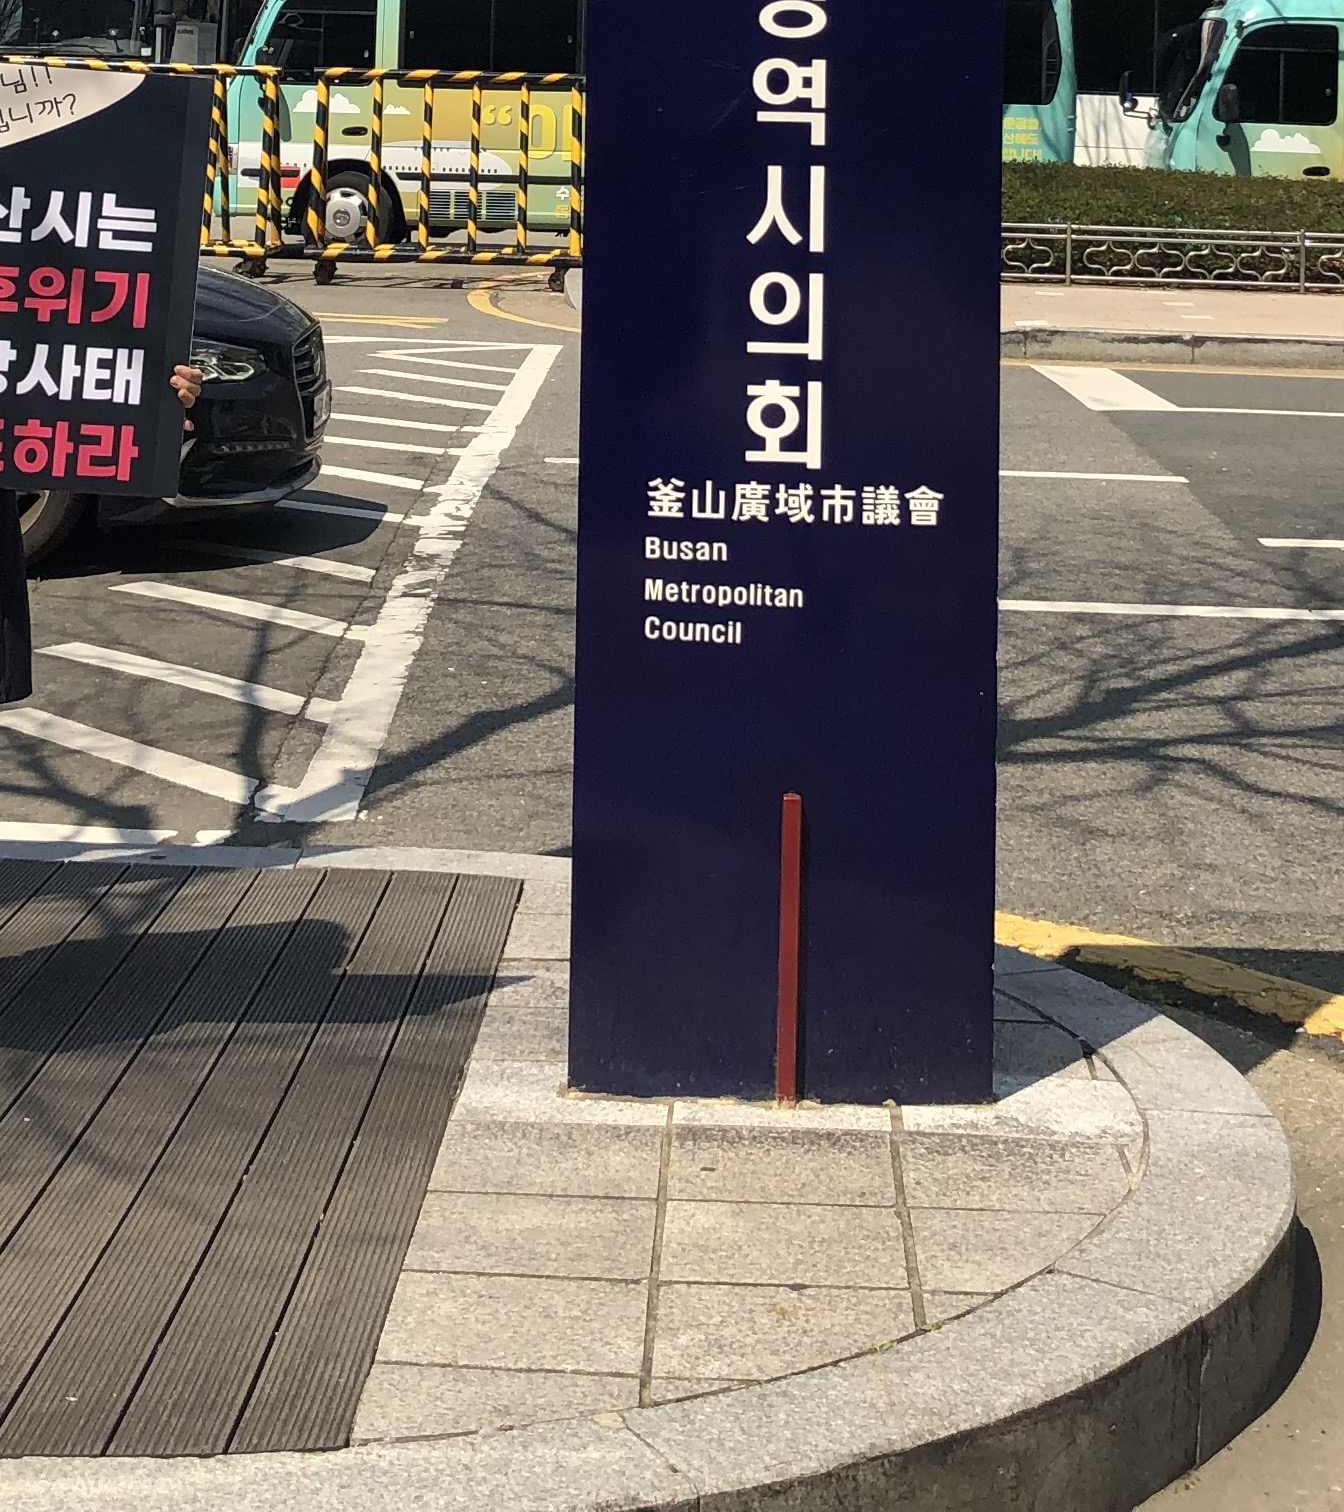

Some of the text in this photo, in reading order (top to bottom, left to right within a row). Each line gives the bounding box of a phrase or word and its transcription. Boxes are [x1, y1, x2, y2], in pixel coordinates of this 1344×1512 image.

[646, 476, 945, 526] 釜山廣域市議會
[644, 536, 729, 562] Busan
[643, 578, 805, 608] Metropolitan
[643, 615, 743, 645] Council
